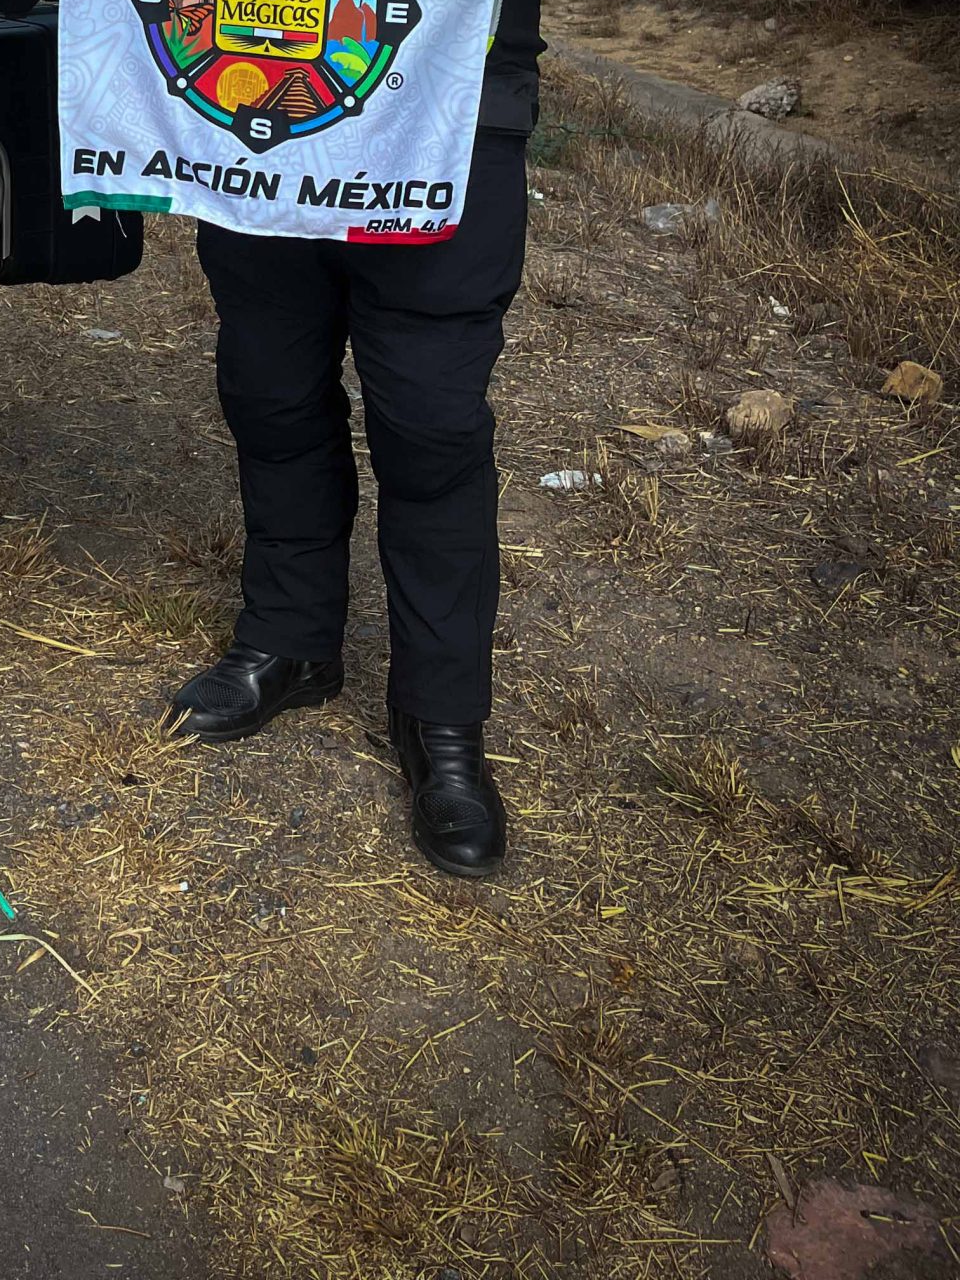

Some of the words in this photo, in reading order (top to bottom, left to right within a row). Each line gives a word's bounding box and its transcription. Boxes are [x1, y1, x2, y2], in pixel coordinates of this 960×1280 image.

[385, 2, 410, 24] E
[250, 117, 272, 140] S
[73, 148, 126, 176] EN
[141, 150, 282, 201] ACCIÓN
[297, 171, 454, 210] MÉXICO
[365, 218, 412, 233] RRM
[420, 217, 449, 233] 4.0
